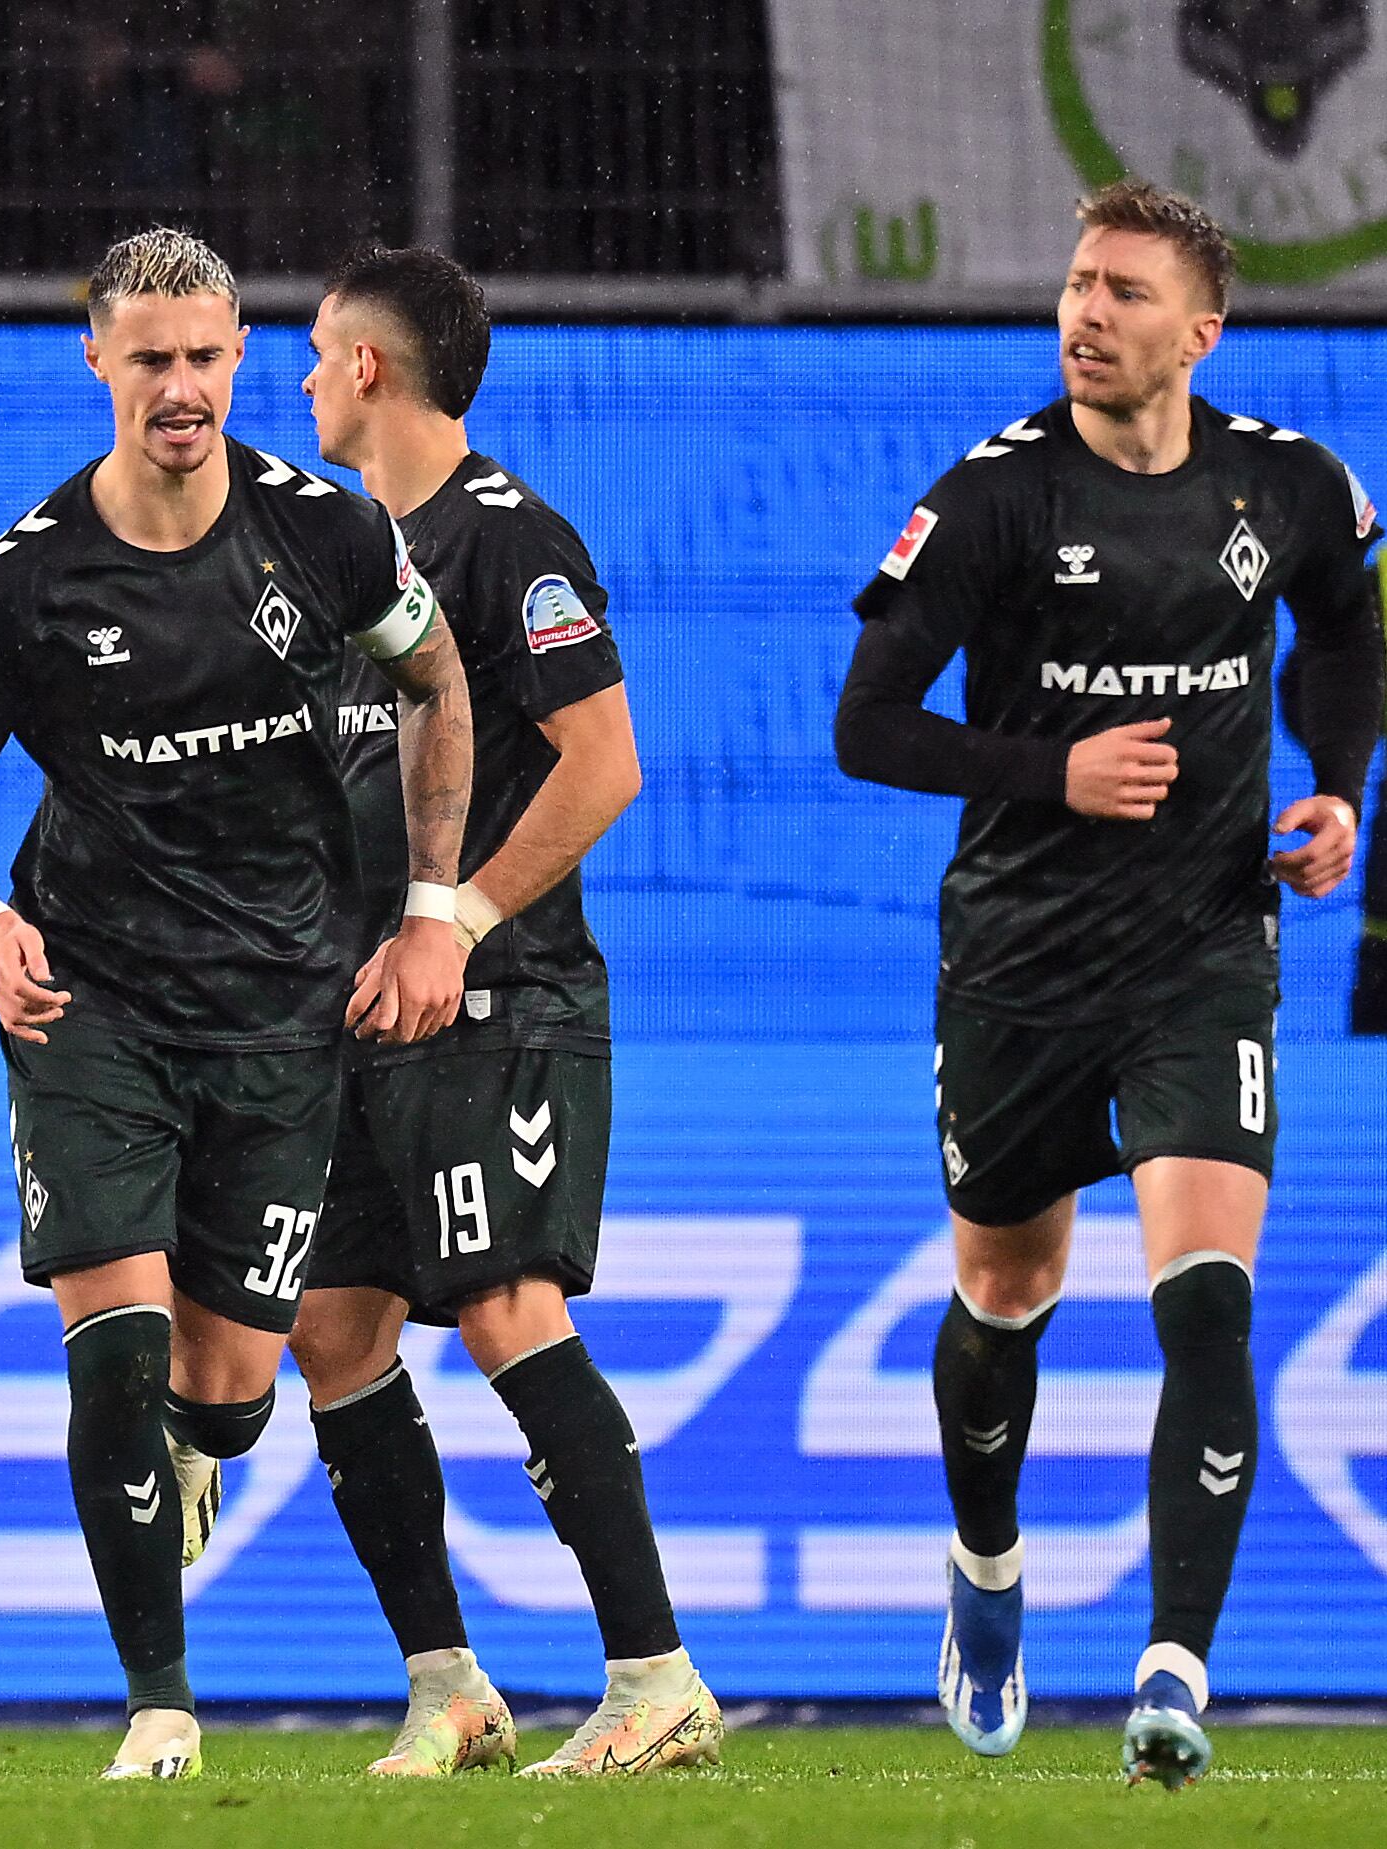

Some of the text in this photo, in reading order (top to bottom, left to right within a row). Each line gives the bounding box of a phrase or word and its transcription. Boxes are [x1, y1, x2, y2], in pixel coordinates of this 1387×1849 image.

[1041, 655, 1249, 695] MATTHÄI
[100, 703, 313, 764] MATTHÄI
[1236, 1038, 1266, 1134] 8
[243, 1203, 318, 1301] 32
[433, 1162, 491, 1259] 19
